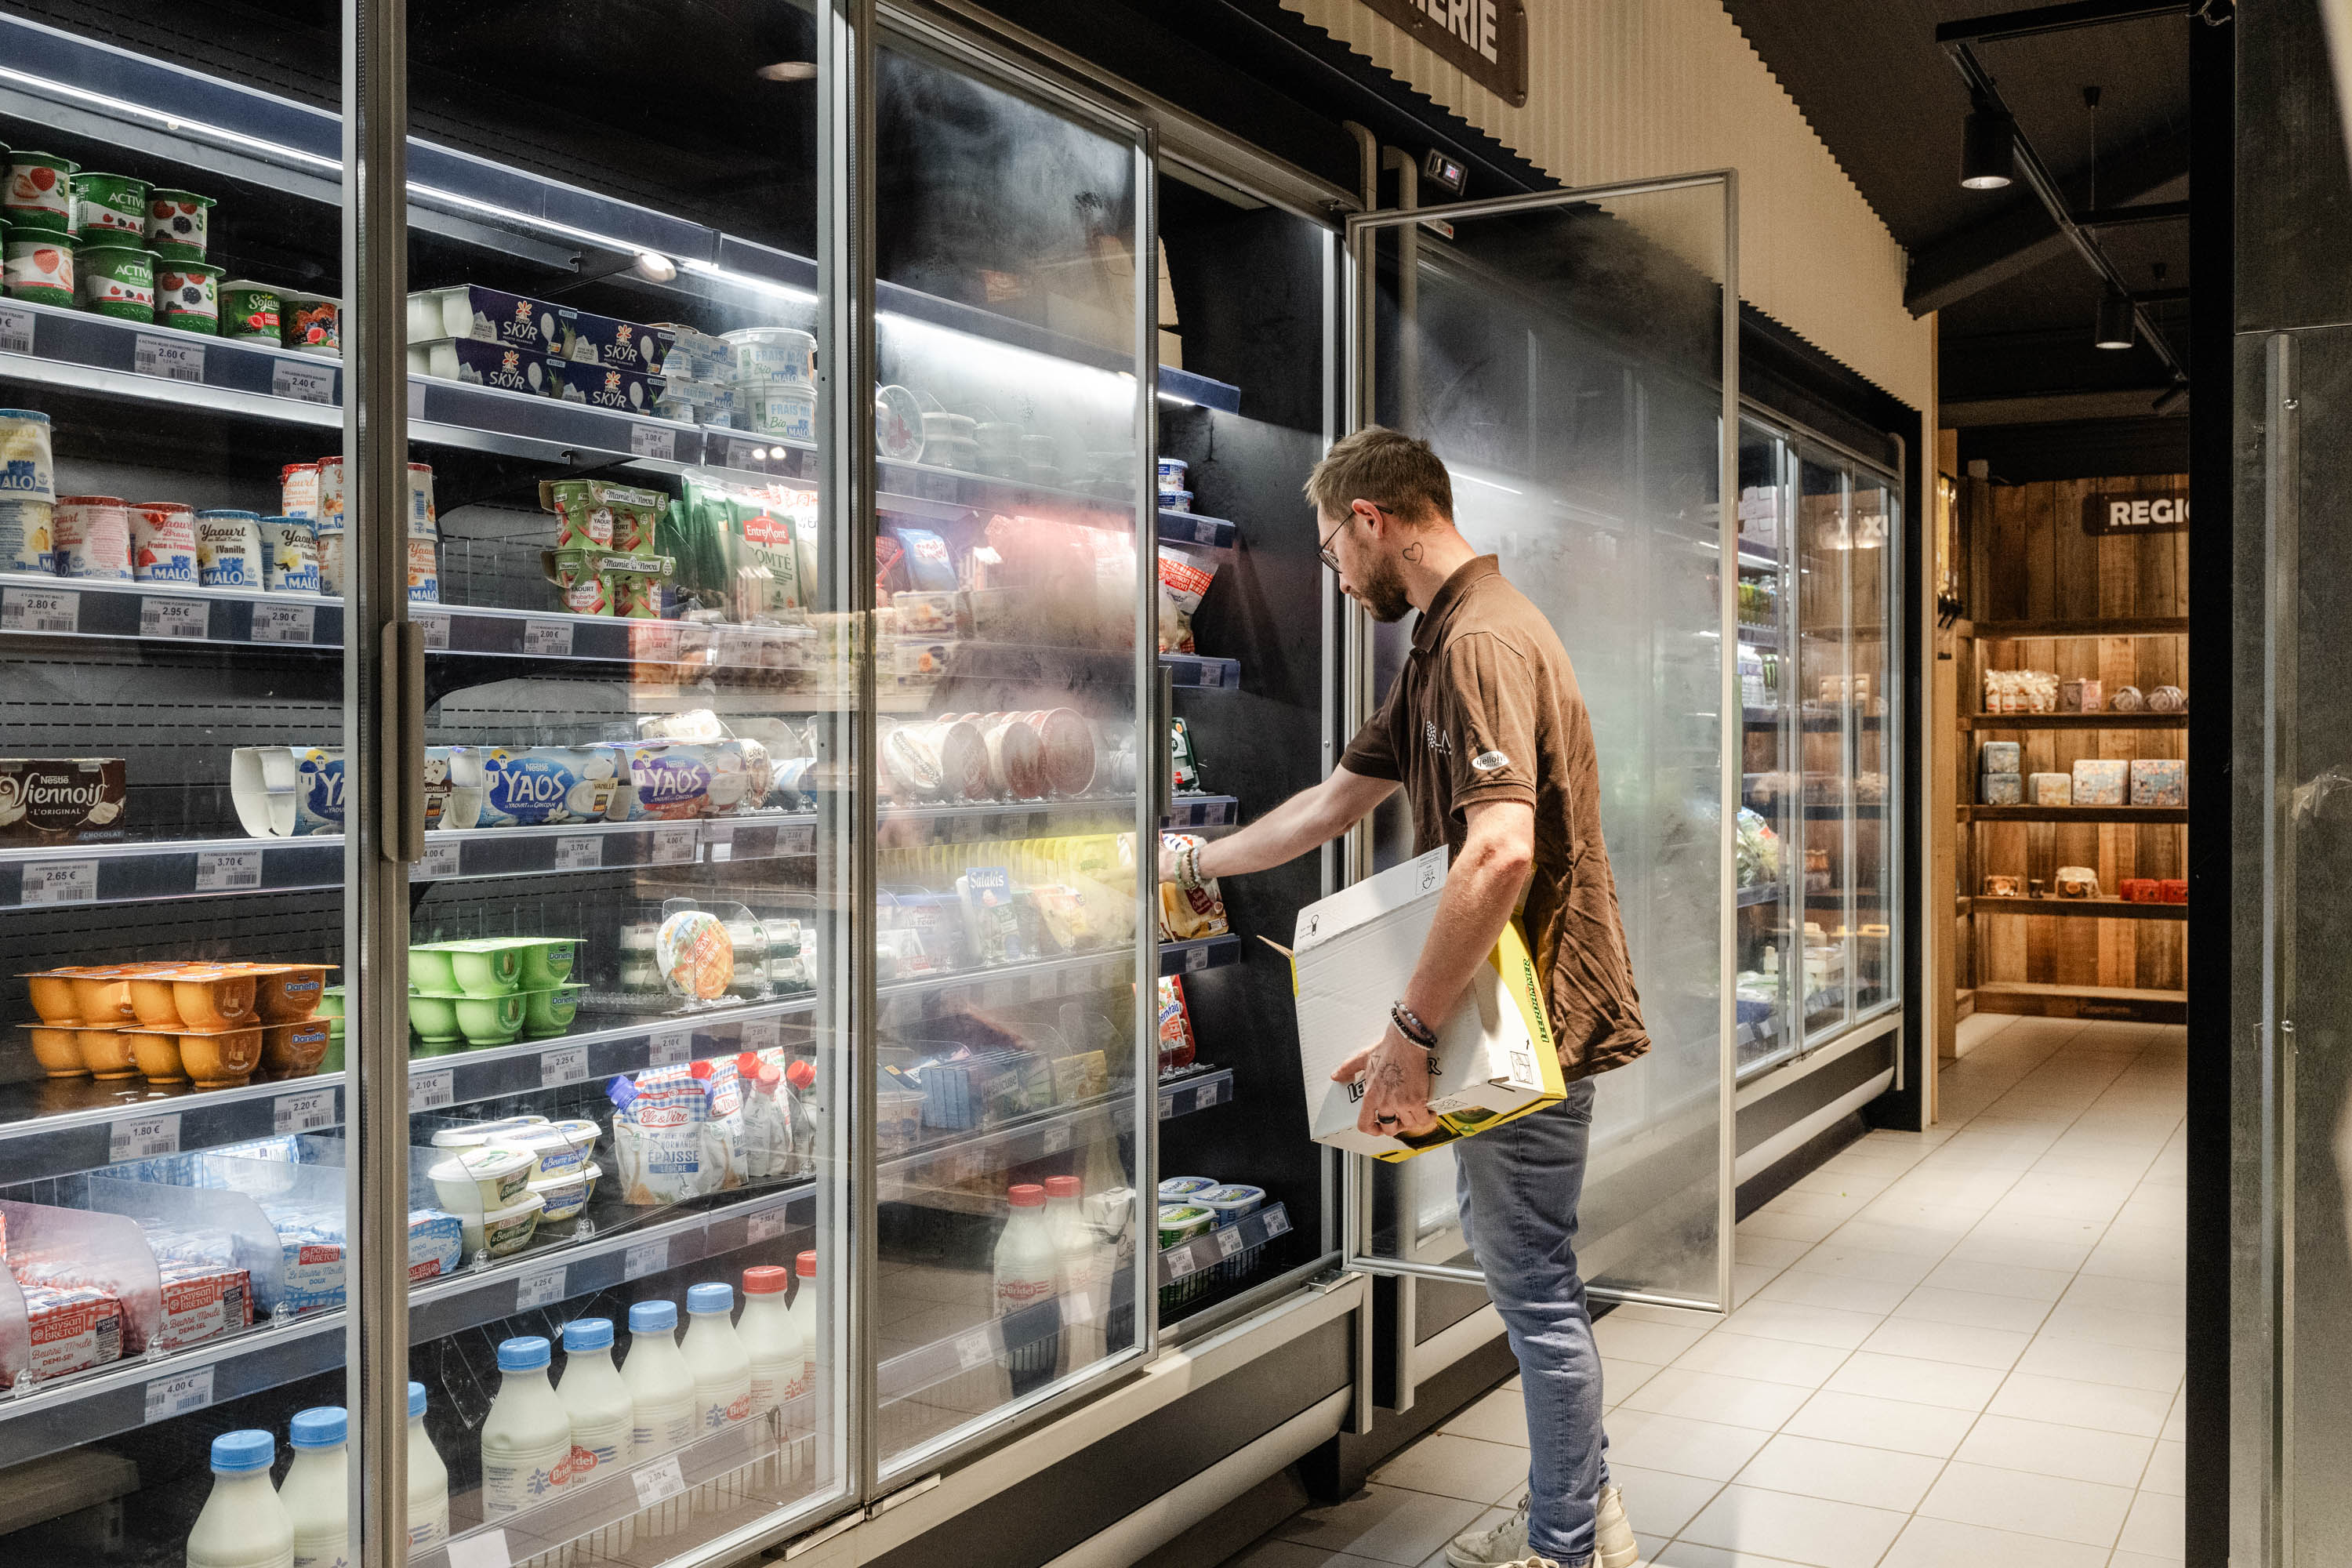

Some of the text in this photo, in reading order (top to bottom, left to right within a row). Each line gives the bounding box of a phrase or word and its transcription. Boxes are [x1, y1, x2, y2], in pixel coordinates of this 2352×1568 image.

[1410, 0, 1497, 64] ERIE
[5, 319, 12, 328] €
[503, 321, 538, 339] SKYR
[158, 348, 185, 360] 2.60 €
[604, 344, 637, 361] SKYR
[712, 353, 728, 363] MALO
[754, 363, 771, 375] Bio
[292, 378, 308, 387] 2.40
[489, 372, 524, 390] SKYR
[773, 373, 798, 383] MALO
[592, 390, 627, 408] SKYR
[716, 400, 733, 408] MALO
[771, 404, 797, 416] FRAIS
[771, 416, 786, 428] Bio
[644, 434, 657, 442] 3.00
[788, 428, 810, 438] MALO
[606, 488, 655, 506] Mamie Nova
[2110, 498, 2189, 527] REGI
[200, 524, 246, 542] Yaourt
[604, 557, 658, 572] Mamie Nova
[154, 568, 191, 581] MALO
[202, 572, 244, 584] MALO
[289, 578, 319, 590] MALO
[411, 588, 437, 601] MALO
[27, 599, 57, 609] 2.80 €
[163, 607, 181, 616] 2.95
[272, 612, 289, 621] 2.90
[501, 770, 565, 803] YAOS
[647, 764, 702, 797] YAOS
[0, 772, 110, 808] Viennois
[34, 808, 81, 816] L'ORIGINAL
[84, 831, 122, 840] CHOCOLAT
[218, 857, 243, 866] 3.70 €
[46, 870, 76, 880] 2.65 €
[970, 871, 1004, 888] Salakis
[549, 952, 573, 960] Danette
[286, 981, 320, 992] Danette
[552, 996, 576, 1005] Danette
[1523, 957, 1550, 1044] LEERDAMMER
[223, 1008, 244, 1018] caramel
[292, 1032, 325, 1044] Danette
[228, 1062, 249, 1071] caramel
[556, 1056, 568, 1066] 2.25
[416, 1079, 437, 1090] 2.10 €
[293, 1101, 310, 1111] 2.20
[640, 1107, 688, 1123] Elle & Vire
[133, 1125, 160, 1136] 1.80 €
[549, 1156, 567, 1167] Beurre
[648, 1149, 699, 1163] ÉPAISSE
[497, 1230, 516, 1241] Beurre
[517, 1225, 532, 1236] Tendre
[310, 1246, 339, 1256] paysan
[310, 1254, 339, 1263] BRETON
[533, 1277, 553, 1287] 4.25 €
[180, 1287, 212, 1301] paysan
[180, 1295, 212, 1310] BRETON
[45, 1316, 82, 1333] paysan
[169, 1307, 220, 1330] Beurre Moulé
[45, 1325, 82, 1341] BRETON
[179, 1322, 206, 1334] DEMI-SEL
[32, 1345, 61, 1360] Beurre
[167, 1379, 194, 1393] 4.00 €
